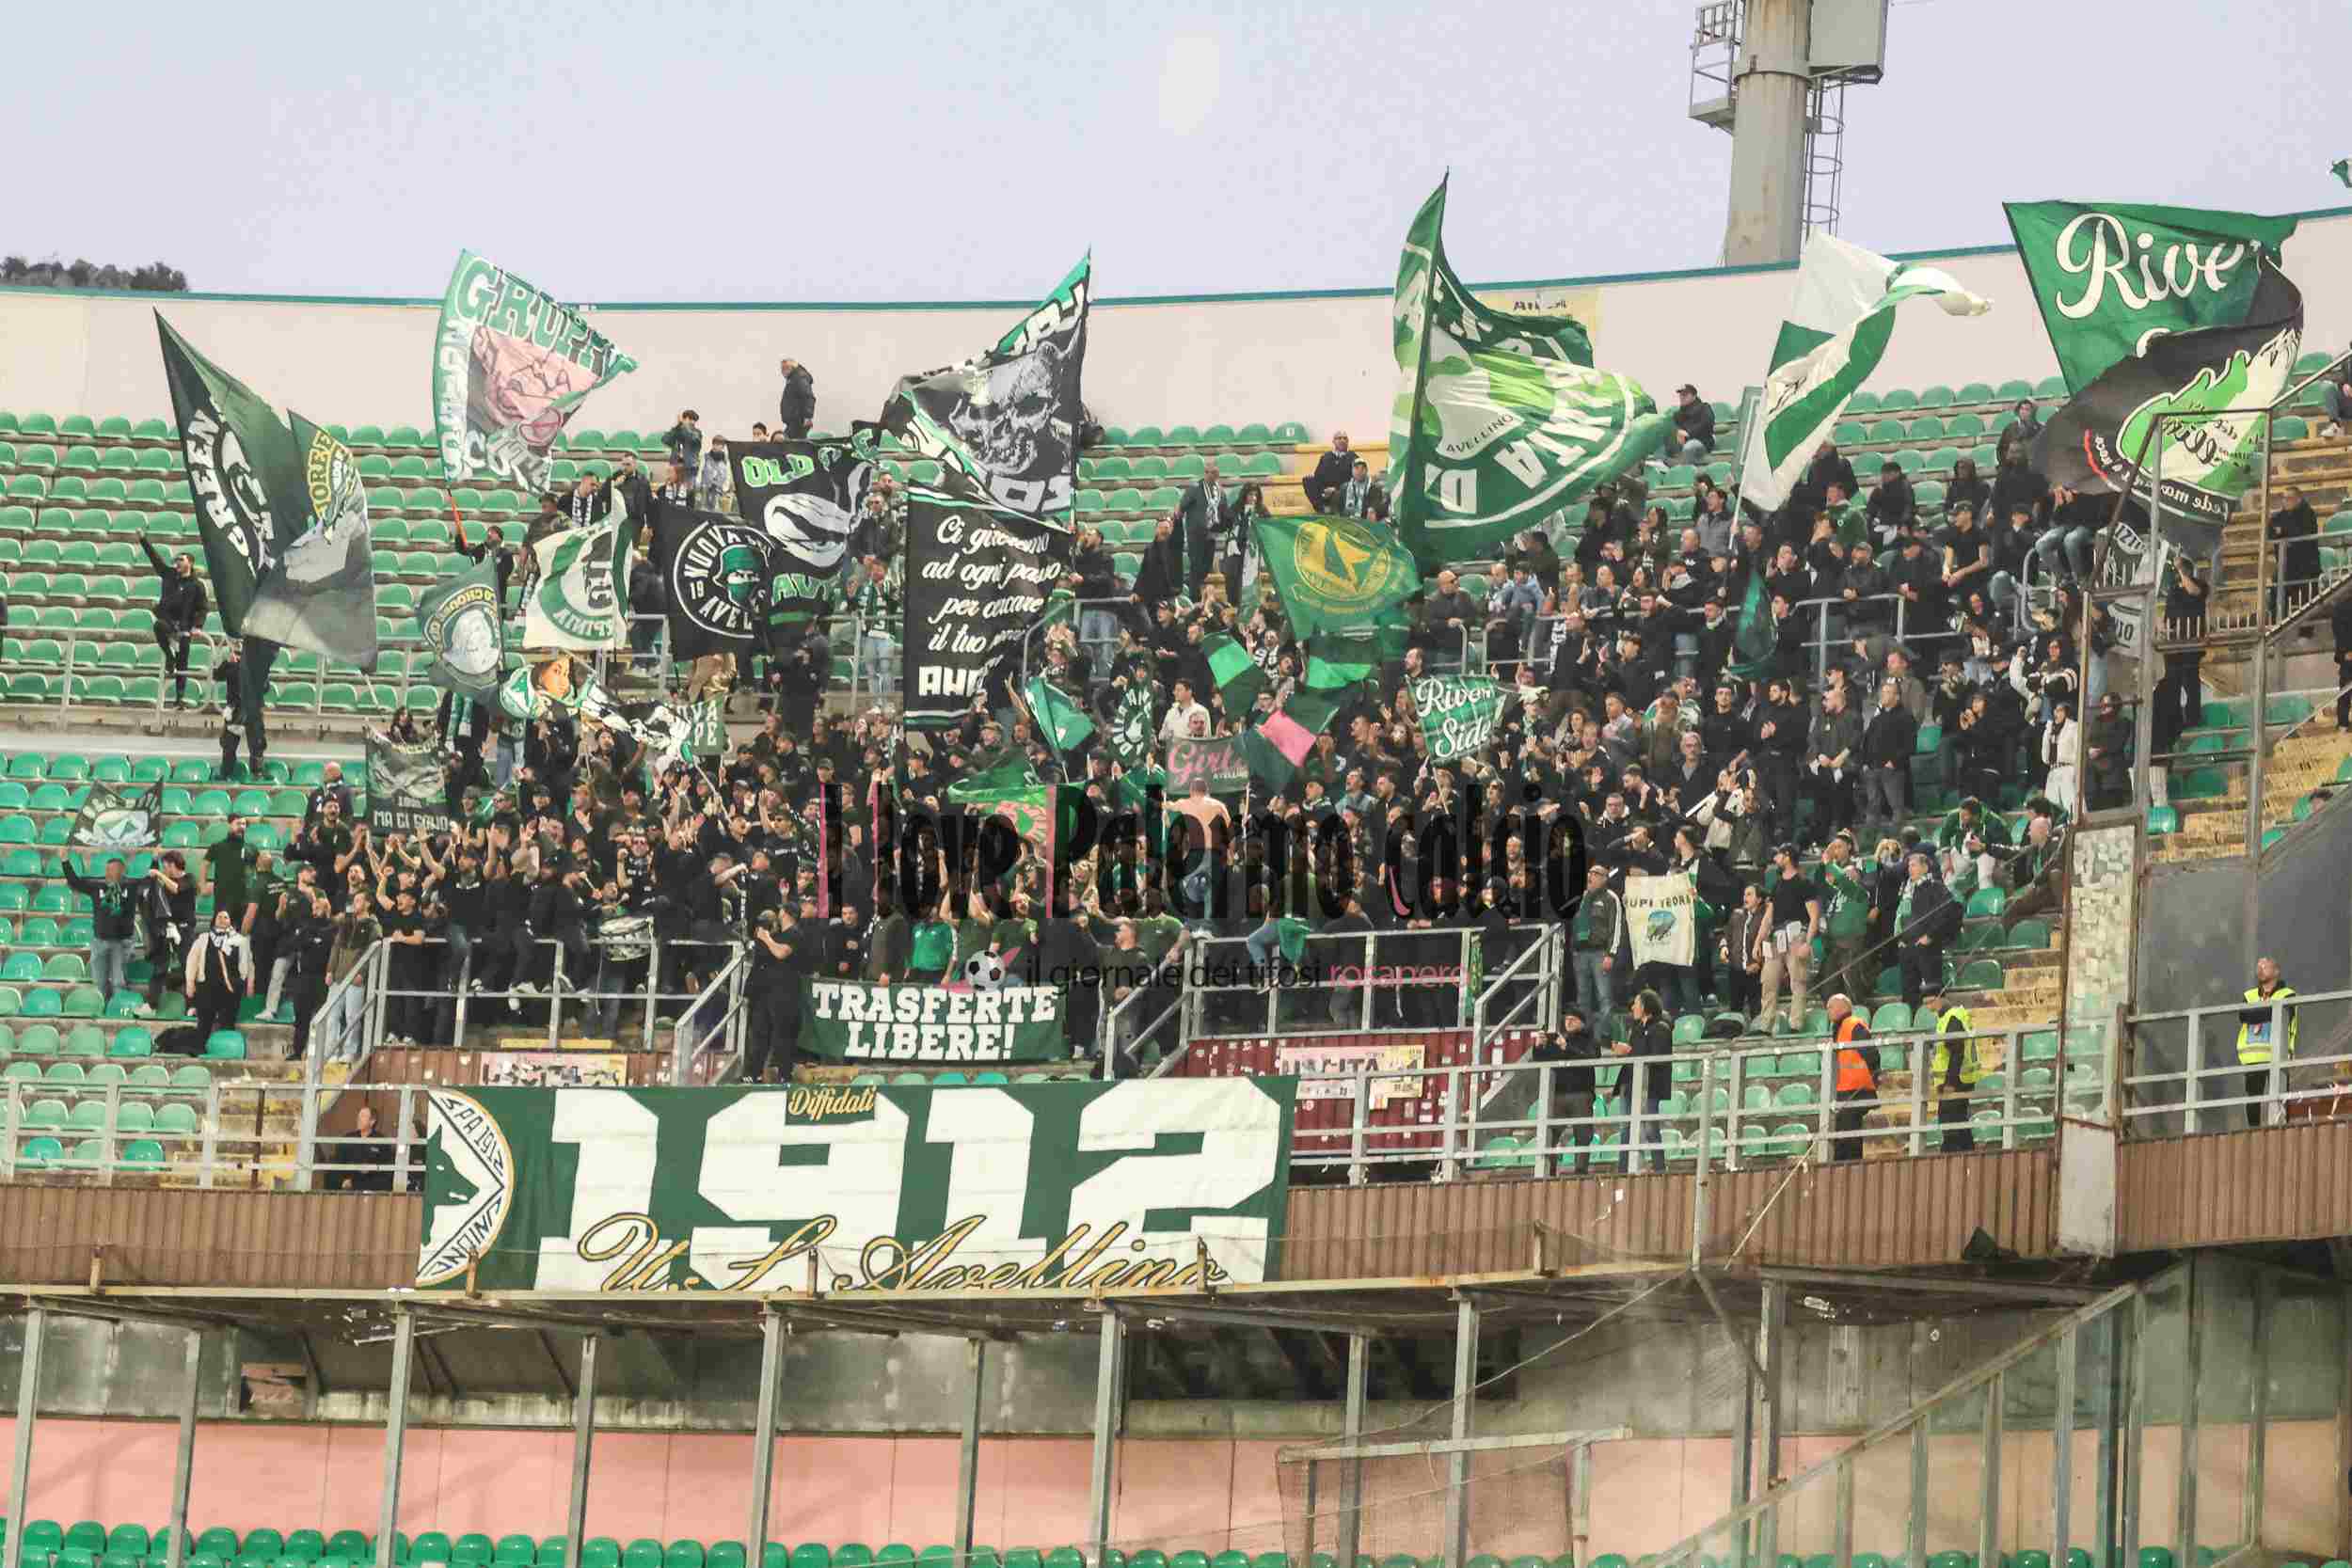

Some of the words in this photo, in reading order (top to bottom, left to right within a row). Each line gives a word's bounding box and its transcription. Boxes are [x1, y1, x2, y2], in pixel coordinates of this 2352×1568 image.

[740, 453, 815, 488] OLD
[936, 515, 964, 545] Ci
[683, 525, 741, 579] NUOVA
[921, 552, 960, 580] ad
[960, 557, 1007, 591] ogni
[928, 595, 980, 625] per
[928, 622, 952, 652] il
[951, 623, 987, 653] tuo
[812, 982, 1059, 1024] TRASFERTE
[844, 1022, 1016, 1061] LIBERE!
[788, 1085, 877, 1121] Diffidati
[534, 1078, 1281, 1294] 1912
[834, 1215, 1234, 1292] Avellino
